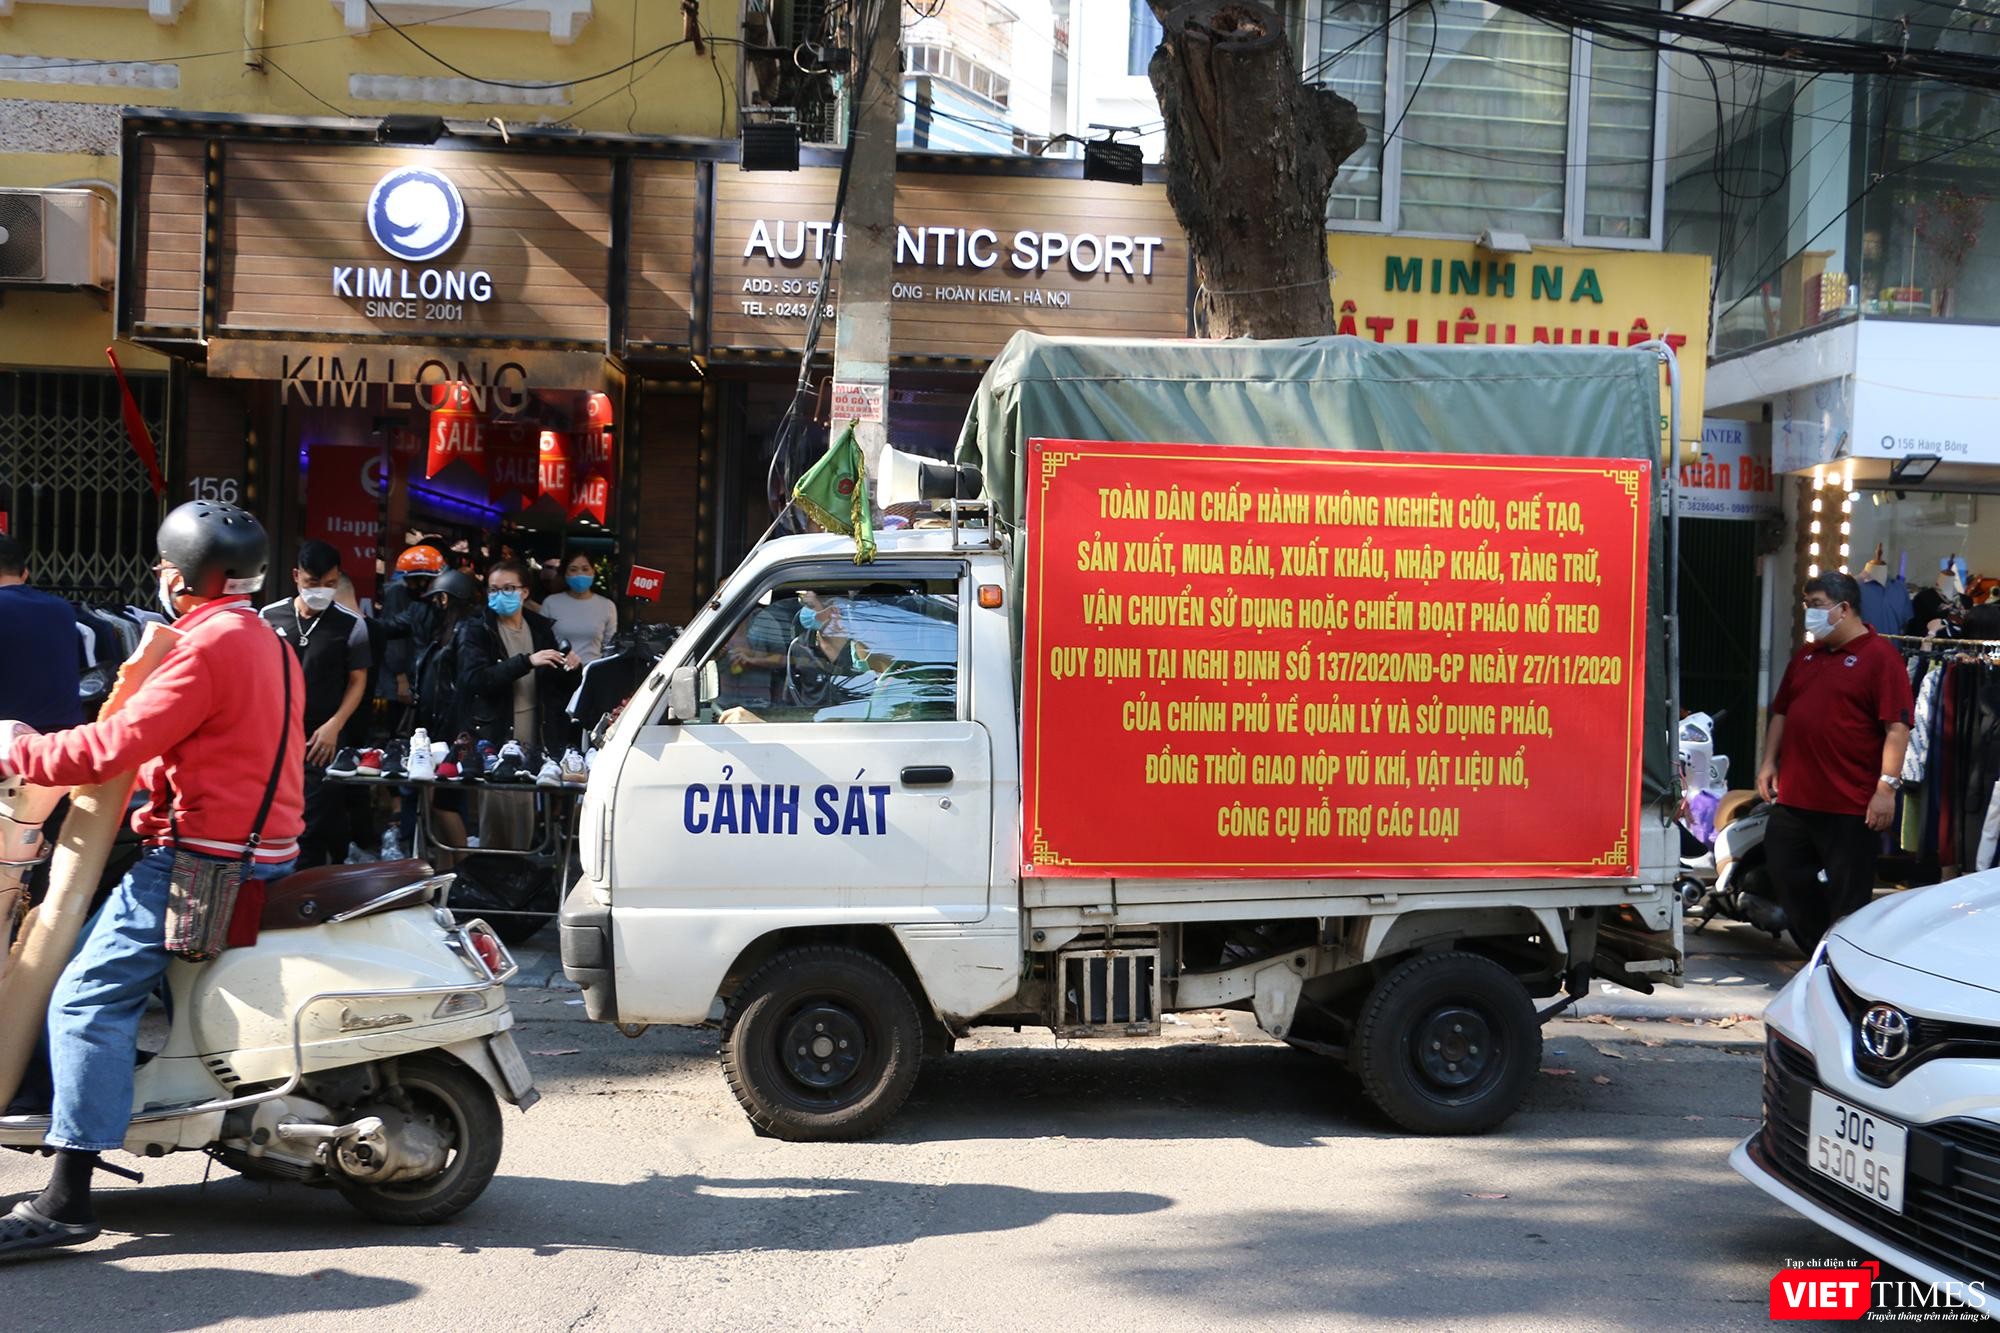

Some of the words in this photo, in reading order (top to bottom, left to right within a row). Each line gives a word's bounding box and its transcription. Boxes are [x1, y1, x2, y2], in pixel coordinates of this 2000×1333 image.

[1011, 230, 1162, 276] SPORT
[333, 266, 392, 298] KIM
[400, 268, 492, 302] LONG
[935, 285, 975, 301] HOÀN
[1023, 288, 1043, 305] HÀ
[1046, 291, 1071, 309] NỘI
[1386, 256, 1516, 298] MINH
[1531, 265, 1603, 303] NA
[365, 301, 417, 319] SINCE
[425, 303, 463, 320] 2001
[281, 354, 367, 408] KIM
[387, 358, 528, 414] LONG
[436, 419, 484, 453] SALE
[1897, 438, 1914, 450] 156
[188, 476, 239, 504] 156
[571, 481, 605, 505] SALE
[1099, 482, 1149, 519] TOÀN
[1155, 484, 1195, 520] DÂN
[1201, 482, 1252, 522] CHẤP
[1258, 487, 1311, 524] HÀNH
[1315, 489, 1380, 526] KHÔNG
[1384, 492, 1454, 528] NGHIÊN
[1459, 493, 1500, 533] CỨU,
[1506, 492, 1543, 531] CHẾ
[1546, 502, 1584, 538] TẠO,
[1077, 531, 1118, 571] SẢN
[1124, 532, 1176, 577] XUẤT,
[1182, 544, 1224, 574] MUA
[1230, 539, 1274, 579] BÁN,
[1280, 536, 1329, 576] XUẤT
[1334, 536, 1389, 582] KHẨU,
[1395, 544, 1446, 586] NHẬP
[1451, 539, 1504, 584] KHẨU,
[1510, 546, 1557, 582] TÀNG
[1563, 548, 1601, 586] TRỮ,
[1083, 588, 1122, 631] VẬN
[1128, 584, 1204, 626] CHUYỂN
[1210, 587, 1238, 627] SỬ
[1241, 598, 1293, 634] DỤNG
[1299, 593, 1348, 635] HOẶC
[1354, 592, 1413, 630] CHIẾM
[1419, 602, 1466, 637] ĐOẠT
[1471, 597, 1519, 632] PHÁO
[1525, 592, 1551, 633] NỔ
[1555, 604, 1599, 633] THEO
[1051, 647, 1088, 680] QUY
[1094, 648, 1141, 684] ĐỊNH
[1147, 649, 1176, 685] TẠI
[1183, 649, 1228, 686] NGHỊ
[1234, 650, 1280, 686] ĐỊNH
[1286, 641, 1311, 680] SỐ
[1317, 652, 1464, 682] 137/2020/NĐ-CP
[1470, 648, 1518, 683] NGÀY
[1523, 655, 1621, 685] 27/11/2020
[1123, 691, 1161, 731] CỦA
[1168, 696, 1226, 731] CHÍNH
[1232, 693, 1270, 732] PHỦ
[1276, 694, 1298, 732] VỀ
[1304, 694, 1355, 736] QUẢN
[1361, 698, 1382, 733] LÝ
[1388, 698, 1410, 733] VÀ
[1416, 695, 1443, 734] SỬ
[1446, 705, 1495, 740] DỤNG
[1501, 700, 1552, 738] PHÁO,
[1146, 744, 1198, 784] ĐỒNG
[1205, 748, 1246, 784] THỜI
[1252, 755, 1295, 784] GIAO
[1302, 749, 1340, 791] NỘP
[1346, 750, 1369, 785] VŨ
[1375, 750, 1410, 788] KHÍ,
[1417, 750, 1450, 791] VẬT
[1455, 751, 1493, 792] LIỆU
[1499, 745, 1528, 789] NỔ,
[684, 764, 800, 835] CẢNH
[813, 767, 891, 836] SÁT
[1218, 801, 1269, 836] CÔNG
[1276, 807, 1300, 843] CỤ
[1306, 797, 1330, 836] HỖ
[1337, 805, 1372, 843] TRỢ
[1377, 801, 1413, 836] CÁC
[1419, 807, 1459, 843] LOẠI
[1835, 1105, 1875, 1151] 30G
[1818, 1135, 1890, 1201] 530.96
